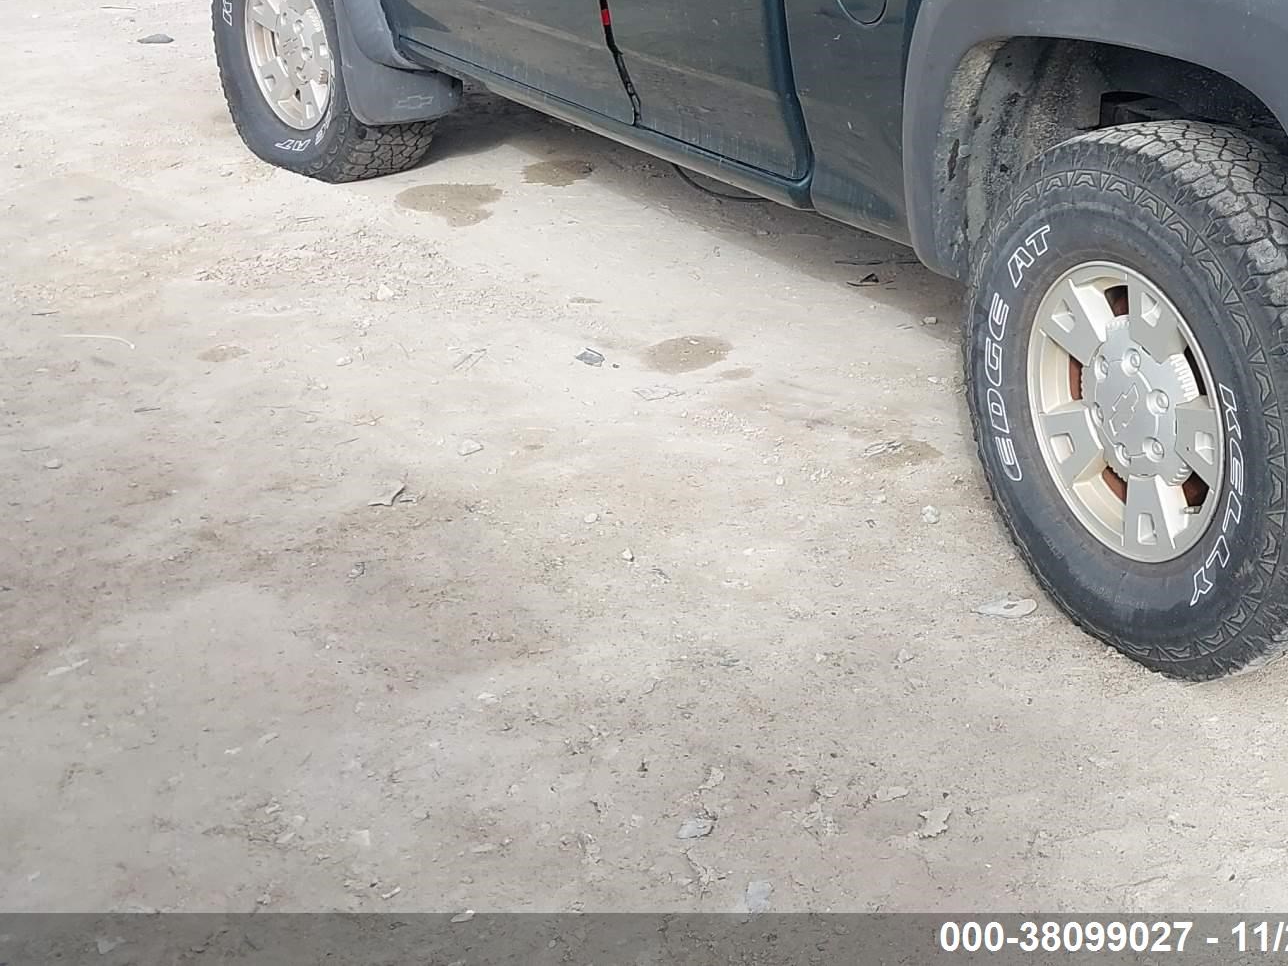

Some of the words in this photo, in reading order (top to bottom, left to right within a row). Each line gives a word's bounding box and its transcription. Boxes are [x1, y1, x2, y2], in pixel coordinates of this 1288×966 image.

[984, 291, 1024, 482] EDGE
[1007, 224, 1052, 288] AT
[1189, 382, 1244, 607] KELLY
